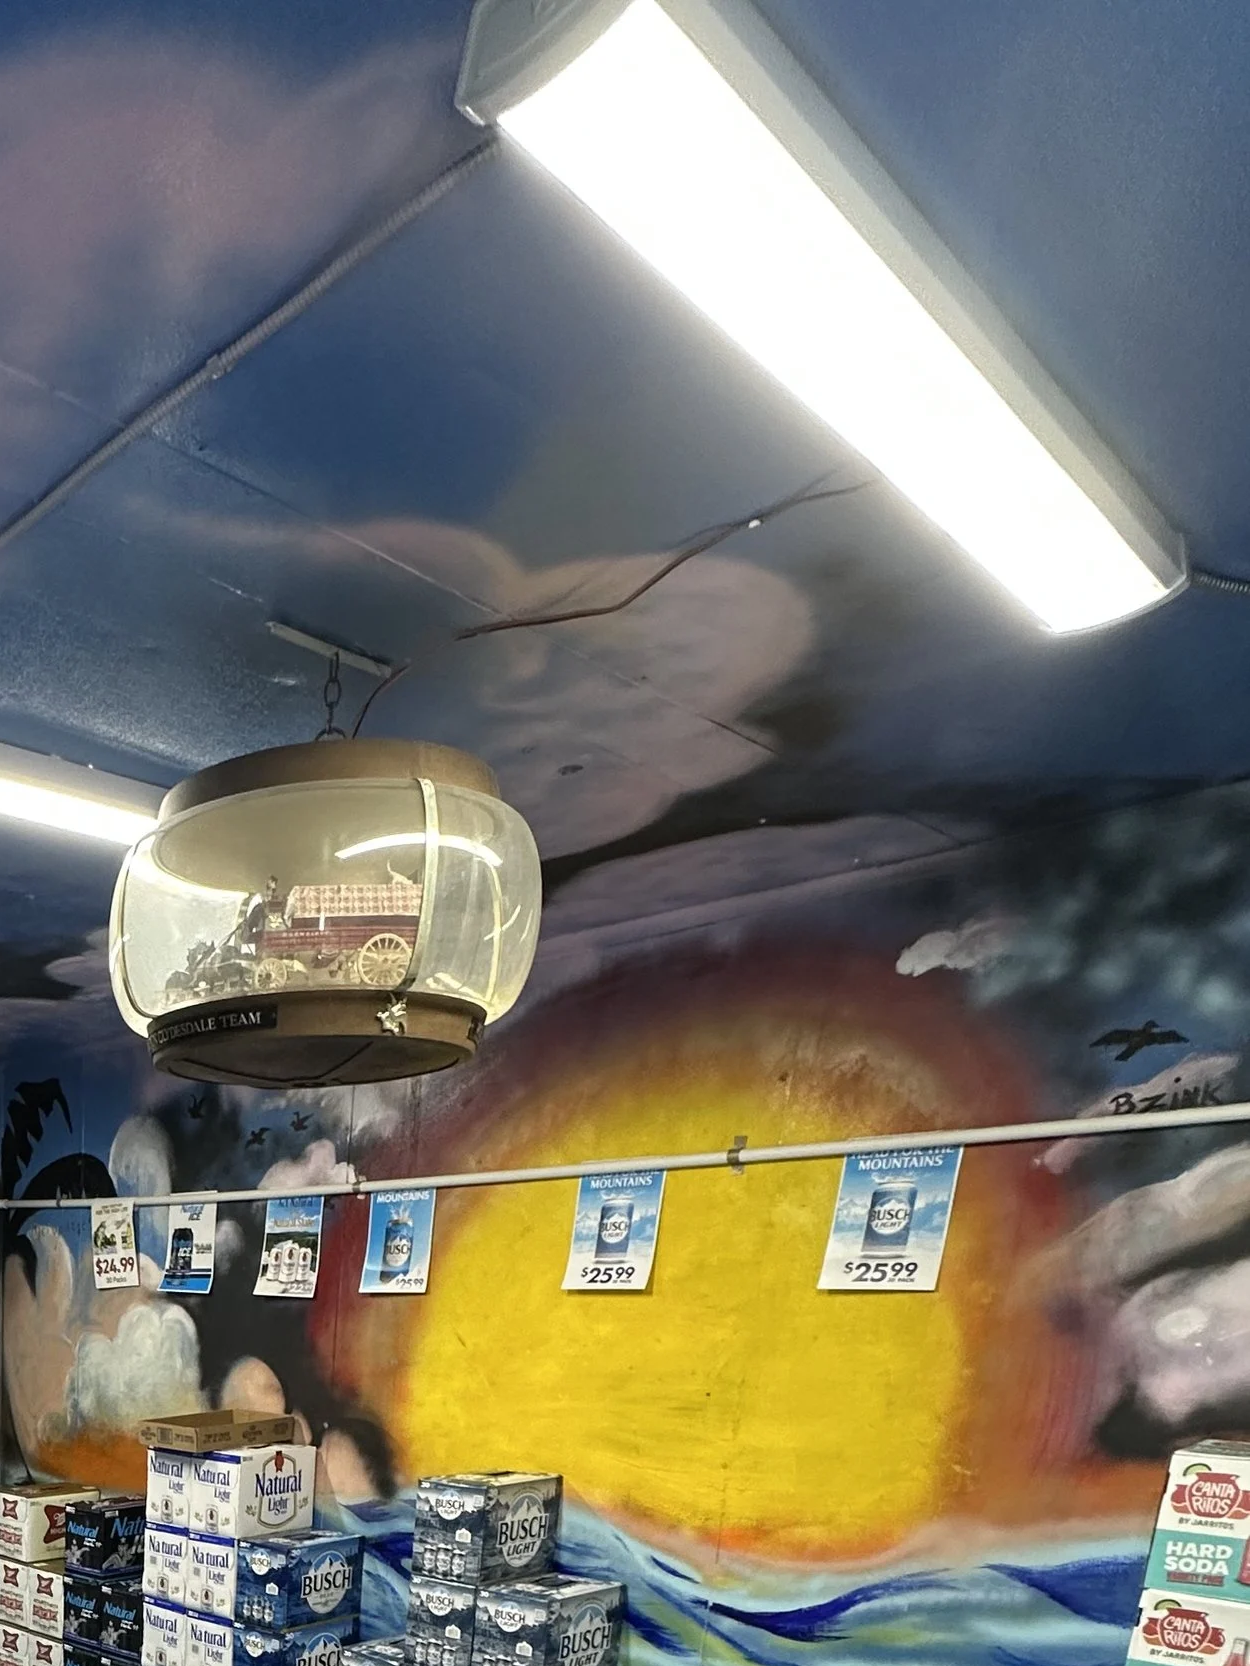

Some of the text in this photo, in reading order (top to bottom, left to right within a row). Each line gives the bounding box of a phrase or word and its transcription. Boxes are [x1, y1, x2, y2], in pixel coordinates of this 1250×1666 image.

[219, 1012, 261, 1028] TEAM
[858, 1155, 943, 1171] MOUNTAINS
[590, 1176, 653, 1189] MOUNTAINS
[96, 1257, 134, 1277] $24.99
[149, 1455, 183, 1479] Natural
[193, 1464, 231, 1487] Natural
[168, 1478, 185, 1494] Light
[1192, 1480, 1236, 1499] CANTA
[268, 1497, 291, 1521] Light
[435, 1498, 465, 1510] BUSCH
[66, 1521, 99, 1538] Natural
[1178, 1517, 1234, 1530] BY JARRITOS
[192, 1546, 230, 1569] Natural
[506, 1541, 538, 1557] LIGHT
[1166, 1541, 1233, 1560] HARD
[1164, 1556, 1229, 1576] SODA
[66, 1592, 96, 1612] Natural
[103, 1600, 136, 1621] Natural
[426, 1594, 454, 1608] BUSCH
[1163, 1615, 1205, 1634] CANTA
[207, 1647, 224, 1664] Light
